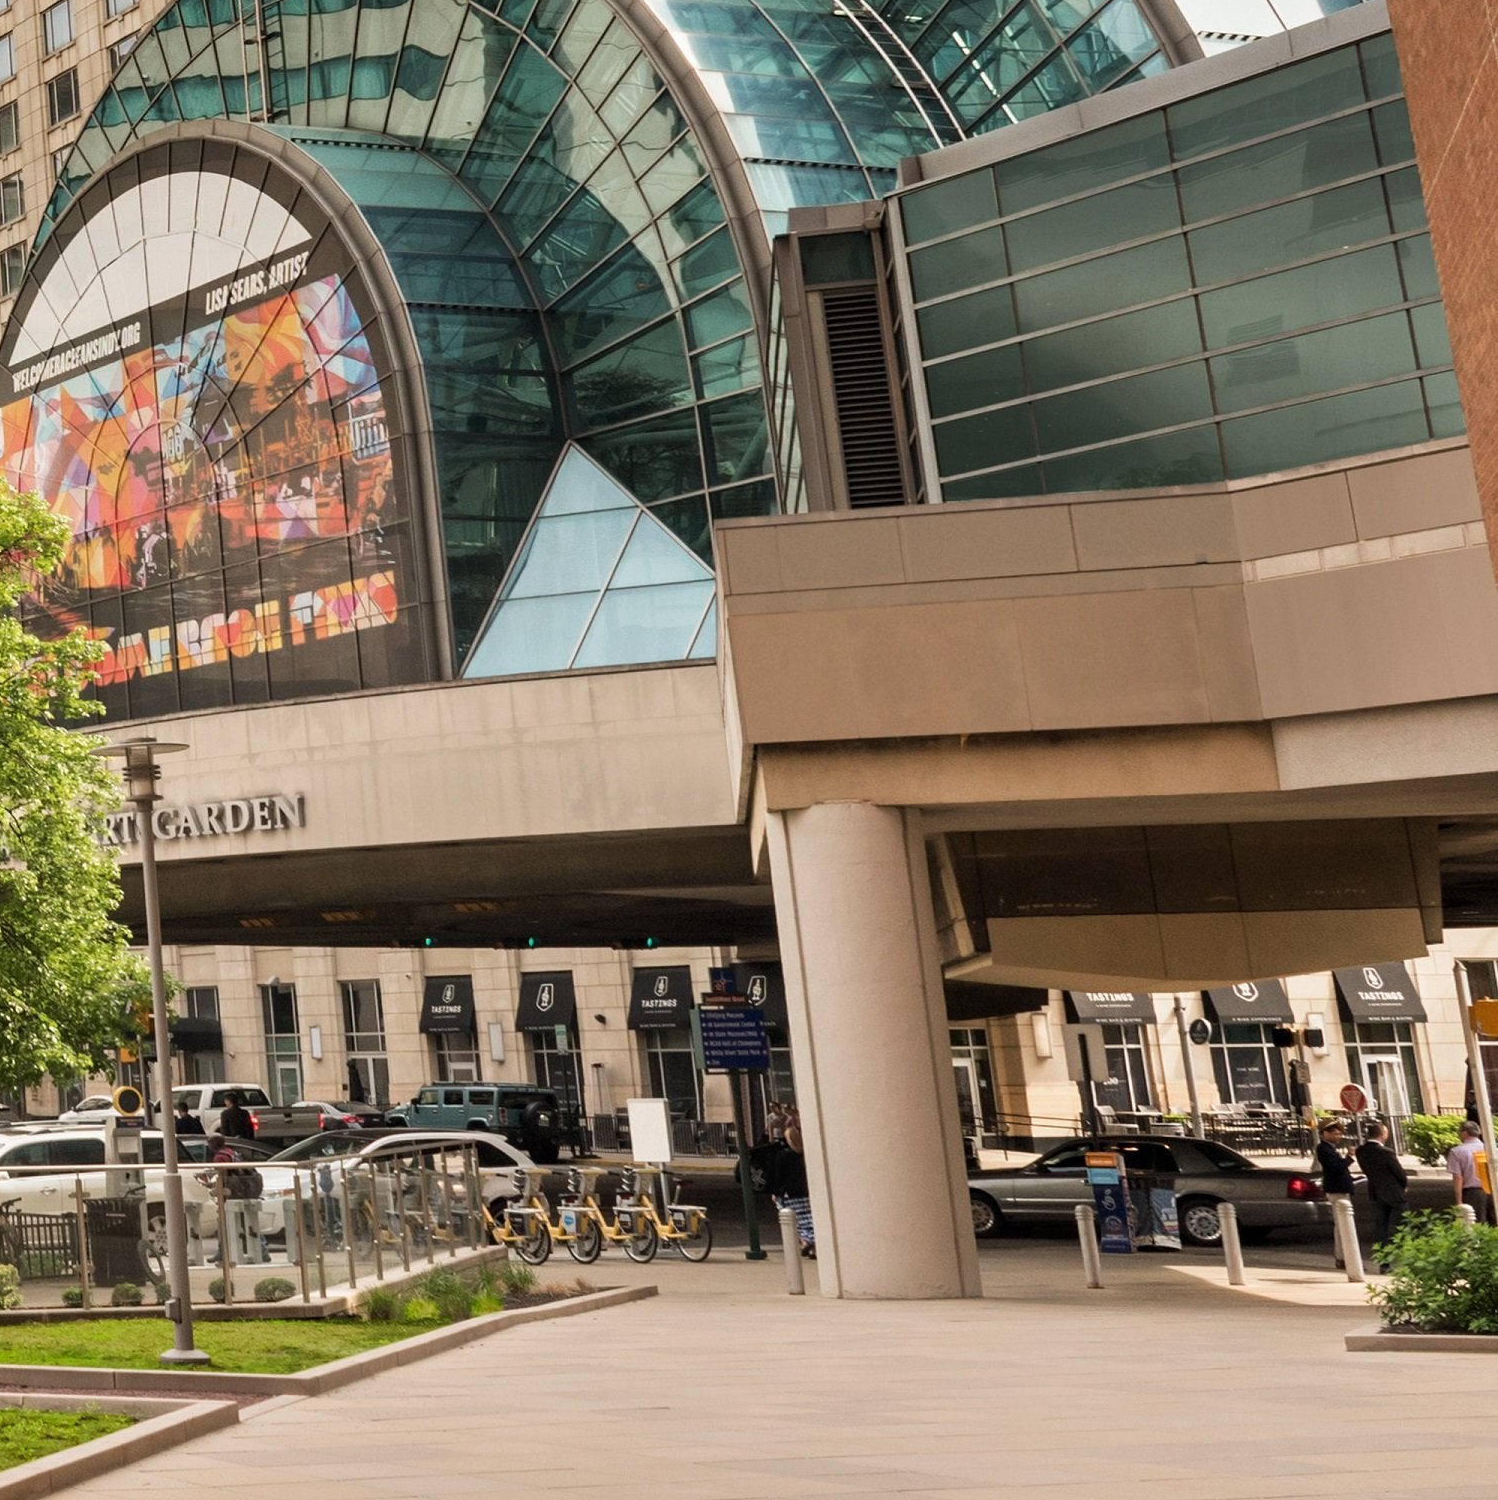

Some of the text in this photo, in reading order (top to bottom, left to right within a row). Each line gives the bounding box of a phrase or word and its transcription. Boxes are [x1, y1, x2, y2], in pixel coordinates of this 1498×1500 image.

[205, 284, 230, 316] LISA
[268, 251, 310, 290] ARTIST
[1086, 992, 1135, 1002] TASTINGS
[1358, 991, 1405, 1001] TASTINGS
[641, 999, 678, 1008] TASTINGS
[431, 1005, 462, 1014] TASTINGS
